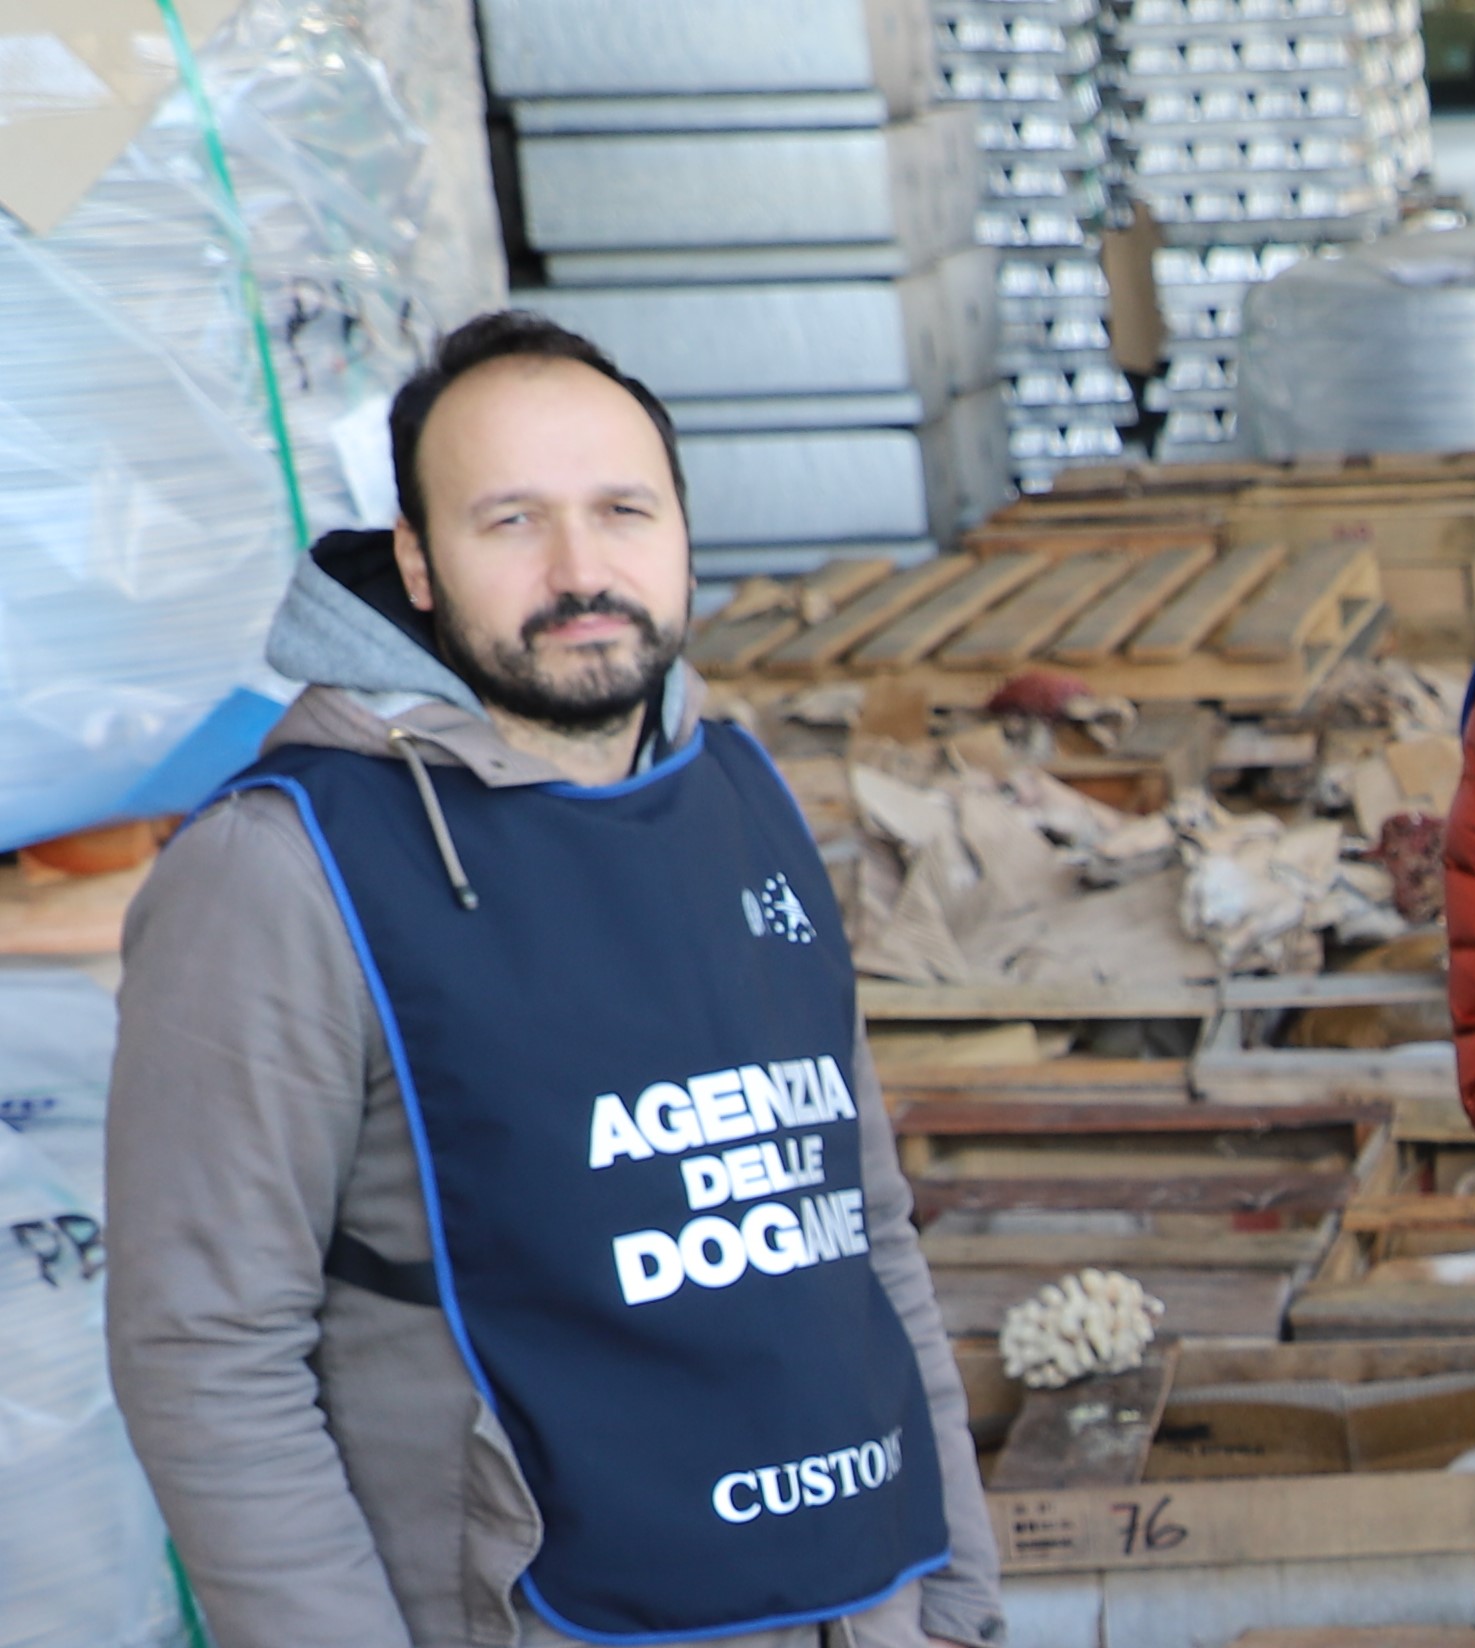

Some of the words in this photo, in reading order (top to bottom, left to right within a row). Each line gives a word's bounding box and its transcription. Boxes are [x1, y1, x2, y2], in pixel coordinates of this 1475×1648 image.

[589, 1054, 857, 1170] AGENZIA
[680, 1134, 825, 1211] DELLE
[612, 1187, 869, 1306] DOGANE
[711, 1425, 903, 1524] CUSTOM
[1110, 1494, 1188, 1557] 76
